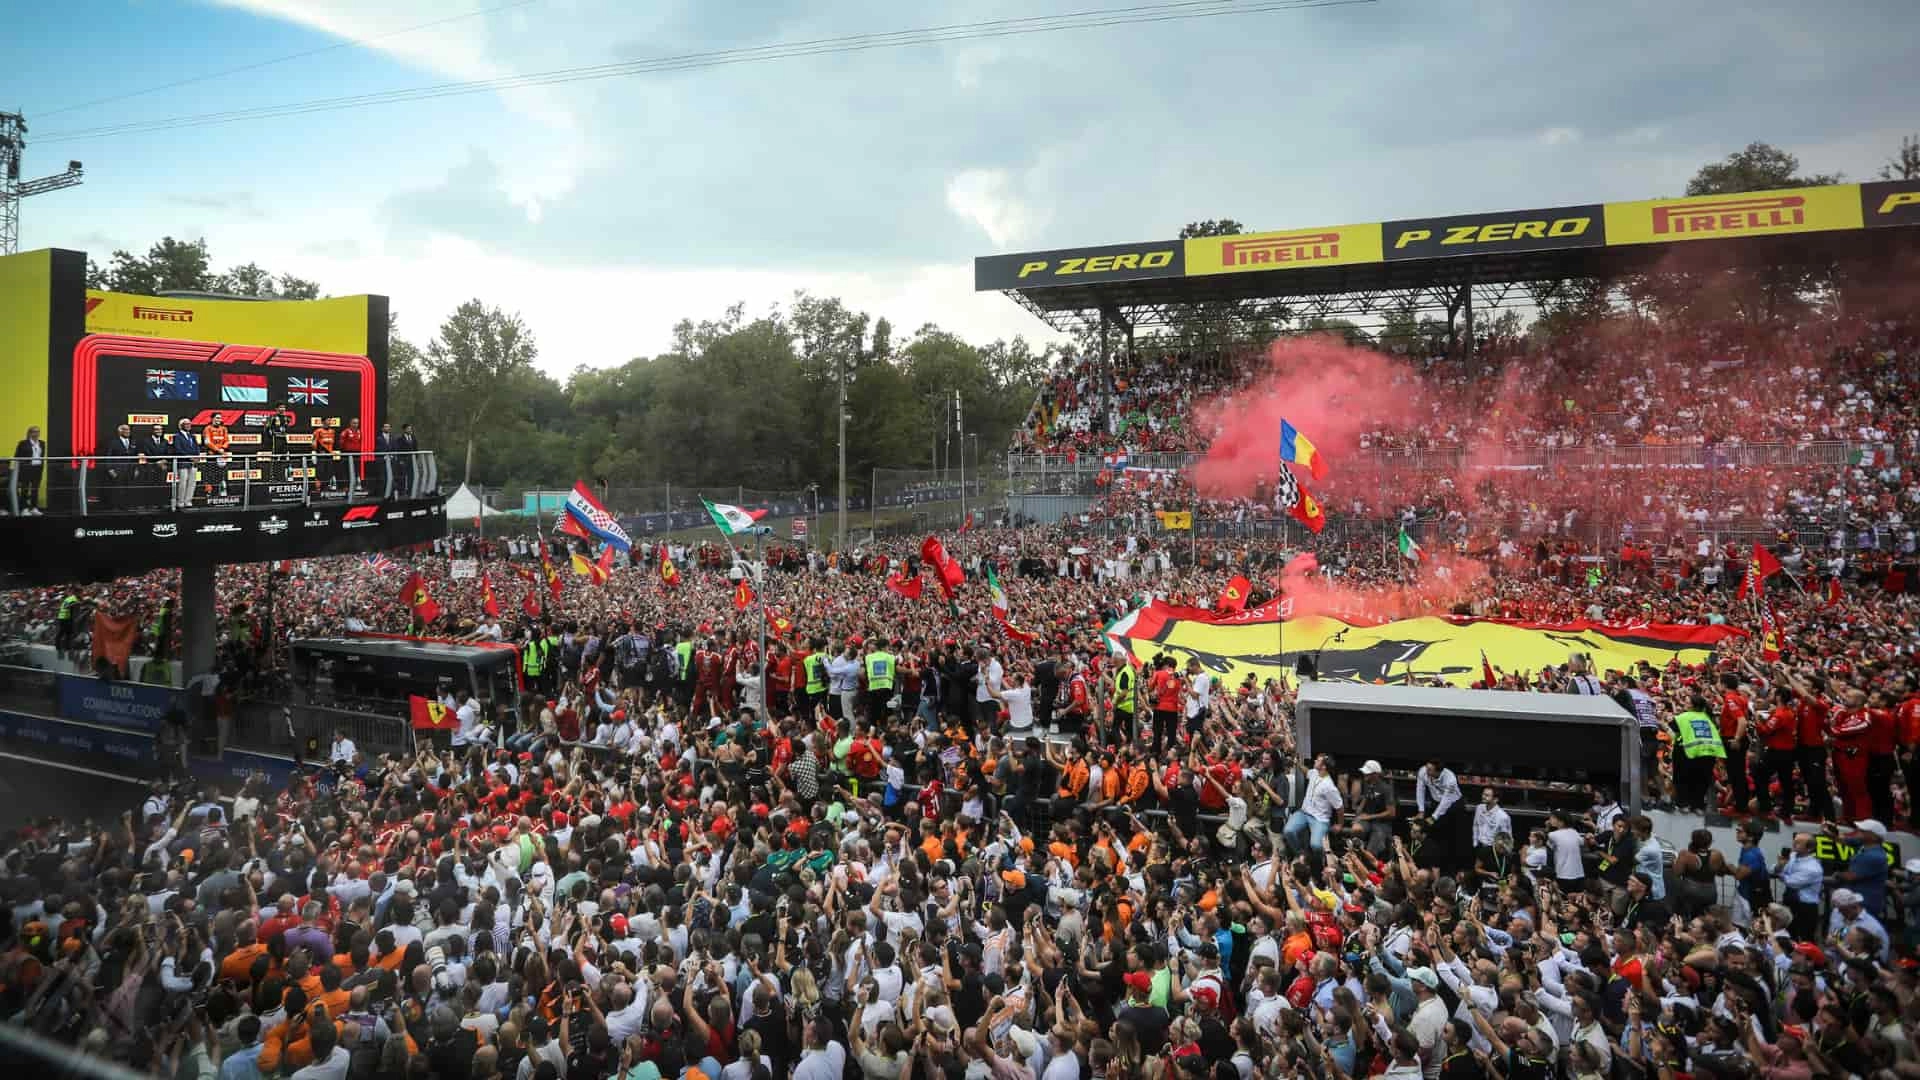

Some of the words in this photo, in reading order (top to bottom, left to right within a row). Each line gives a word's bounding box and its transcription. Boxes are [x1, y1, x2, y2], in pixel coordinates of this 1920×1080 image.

[1652, 196, 1806, 235] PIRELLI
[1394, 229, 1431, 249] P
[1440, 216, 1591, 244] ZERO
[1222, 232, 1340, 267] PIRELLI
[1018, 261, 1048, 278] P
[1054, 250, 1175, 275] ZERO
[133, 306, 193, 322] PIRELLI
[269, 484, 304, 494] FERRA
[86, 528, 134, 538] crypto.com
[153, 523, 177, 532] aws
